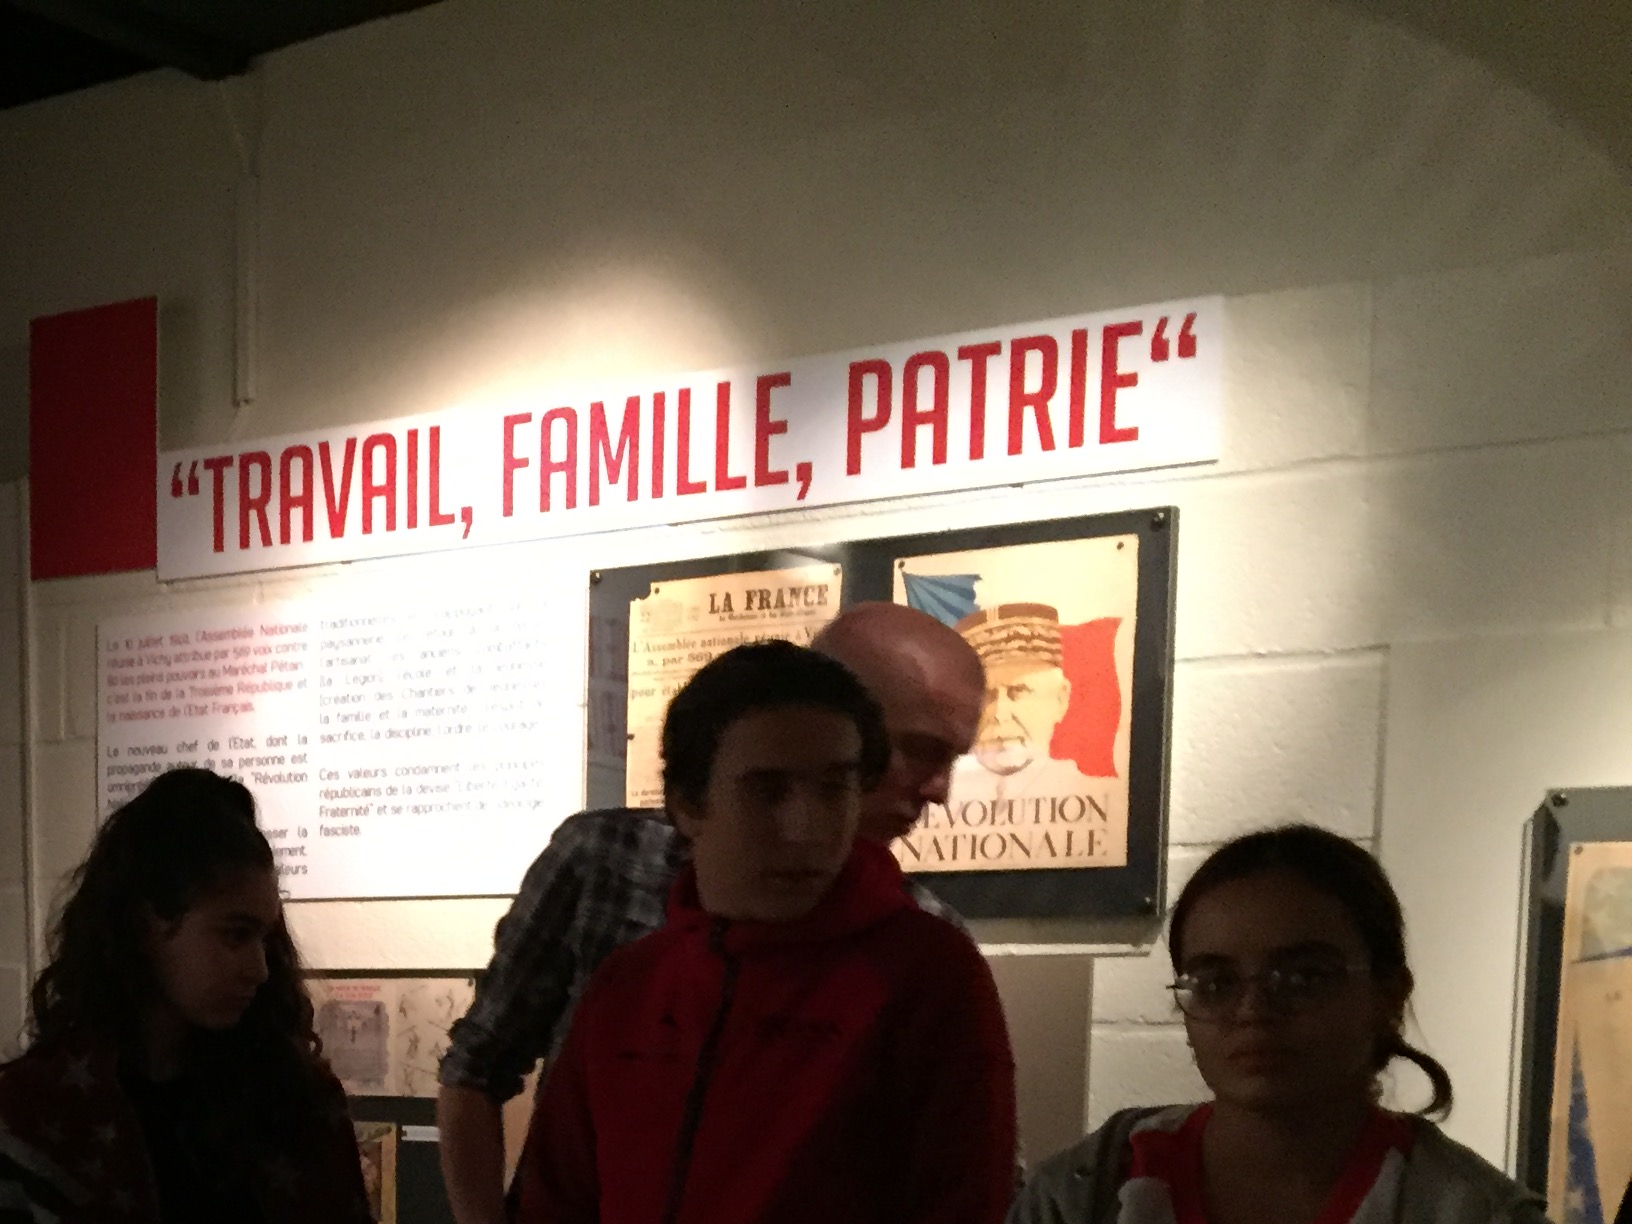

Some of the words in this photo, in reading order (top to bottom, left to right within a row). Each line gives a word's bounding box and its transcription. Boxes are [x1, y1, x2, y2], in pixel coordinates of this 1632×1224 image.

[502, 371, 813, 517] FAMILLE,
[709, 592, 733, 614] LA
[745, 585, 828, 611] FRANCE
[260, 622, 308, 636] Nationale
[276, 641, 308, 654] contre
[663, 656, 683, 666] par
[298, 678, 307, 689] et
[320, 712, 329, 724] la
[379, 709, 389, 721] et
[107, 746, 119, 759] Le
[128, 744, 167, 756] nouveau
[176, 740, 198, 753] chef
[208, 739, 219, 751] de
[266, 735, 287, 747] dont
[298, 734, 307, 746] la
[222, 758, 233, 769] sa
[239, 753, 285, 769] personne
[291, 753, 307, 764] est
[319, 768, 339, 781] Ces
[348, 766, 387, 779] valeurs
[320, 786, 382, 800] républicains
[386, 784, 398, 796] de
[402, 784, 412, 795] la
[377, 804, 387, 815] et
[391, 805, 402, 815] se
[298, 827, 308, 838] la
[898, 830, 1109, 862] NATIONALE
